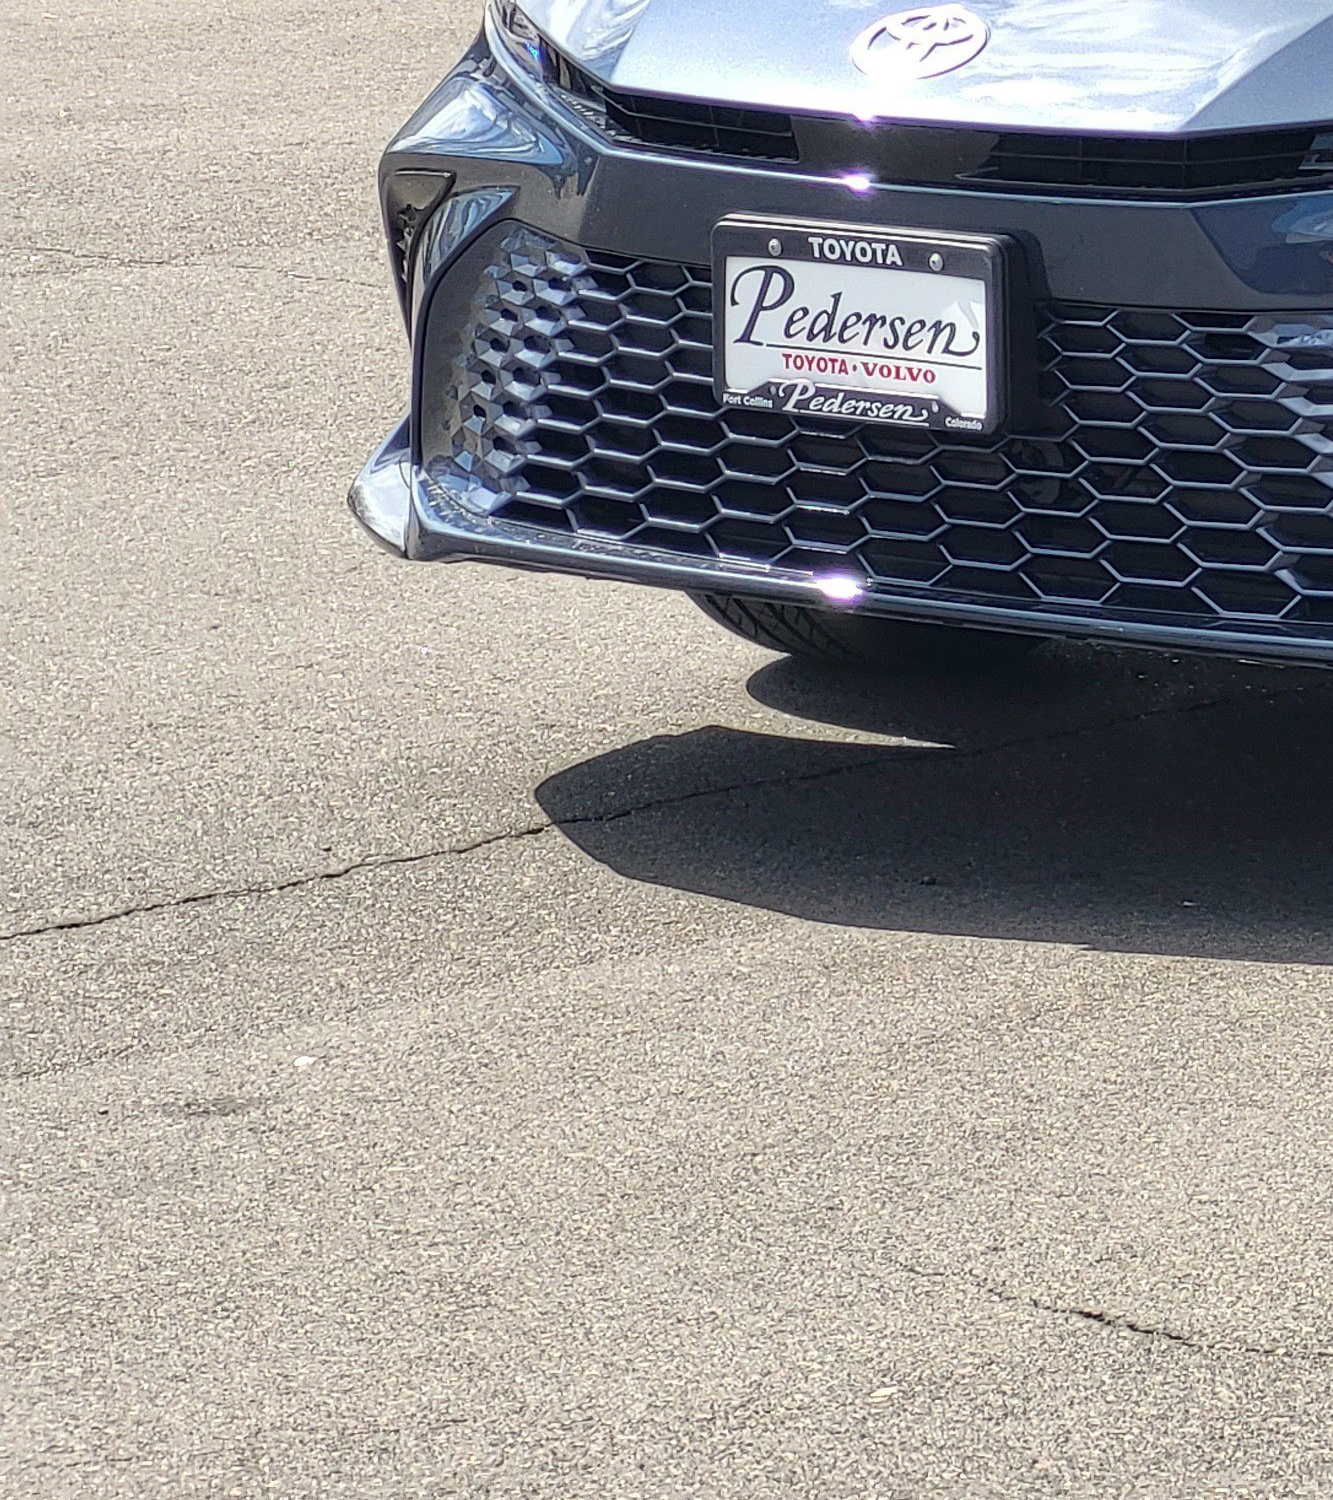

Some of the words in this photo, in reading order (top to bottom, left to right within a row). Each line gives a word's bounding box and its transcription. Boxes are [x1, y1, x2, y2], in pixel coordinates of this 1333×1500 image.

[808, 236, 903, 267] TOYOTA
[730, 264, 981, 357] Pedersen
[781, 352, 850, 376] TOYOTA
[862, 361, 937, 384] VOLVO
[722, 393, 741, 405] Fort
[777, 379, 930, 423] Pedersen
[944, 416, 983, 431] Colorado
